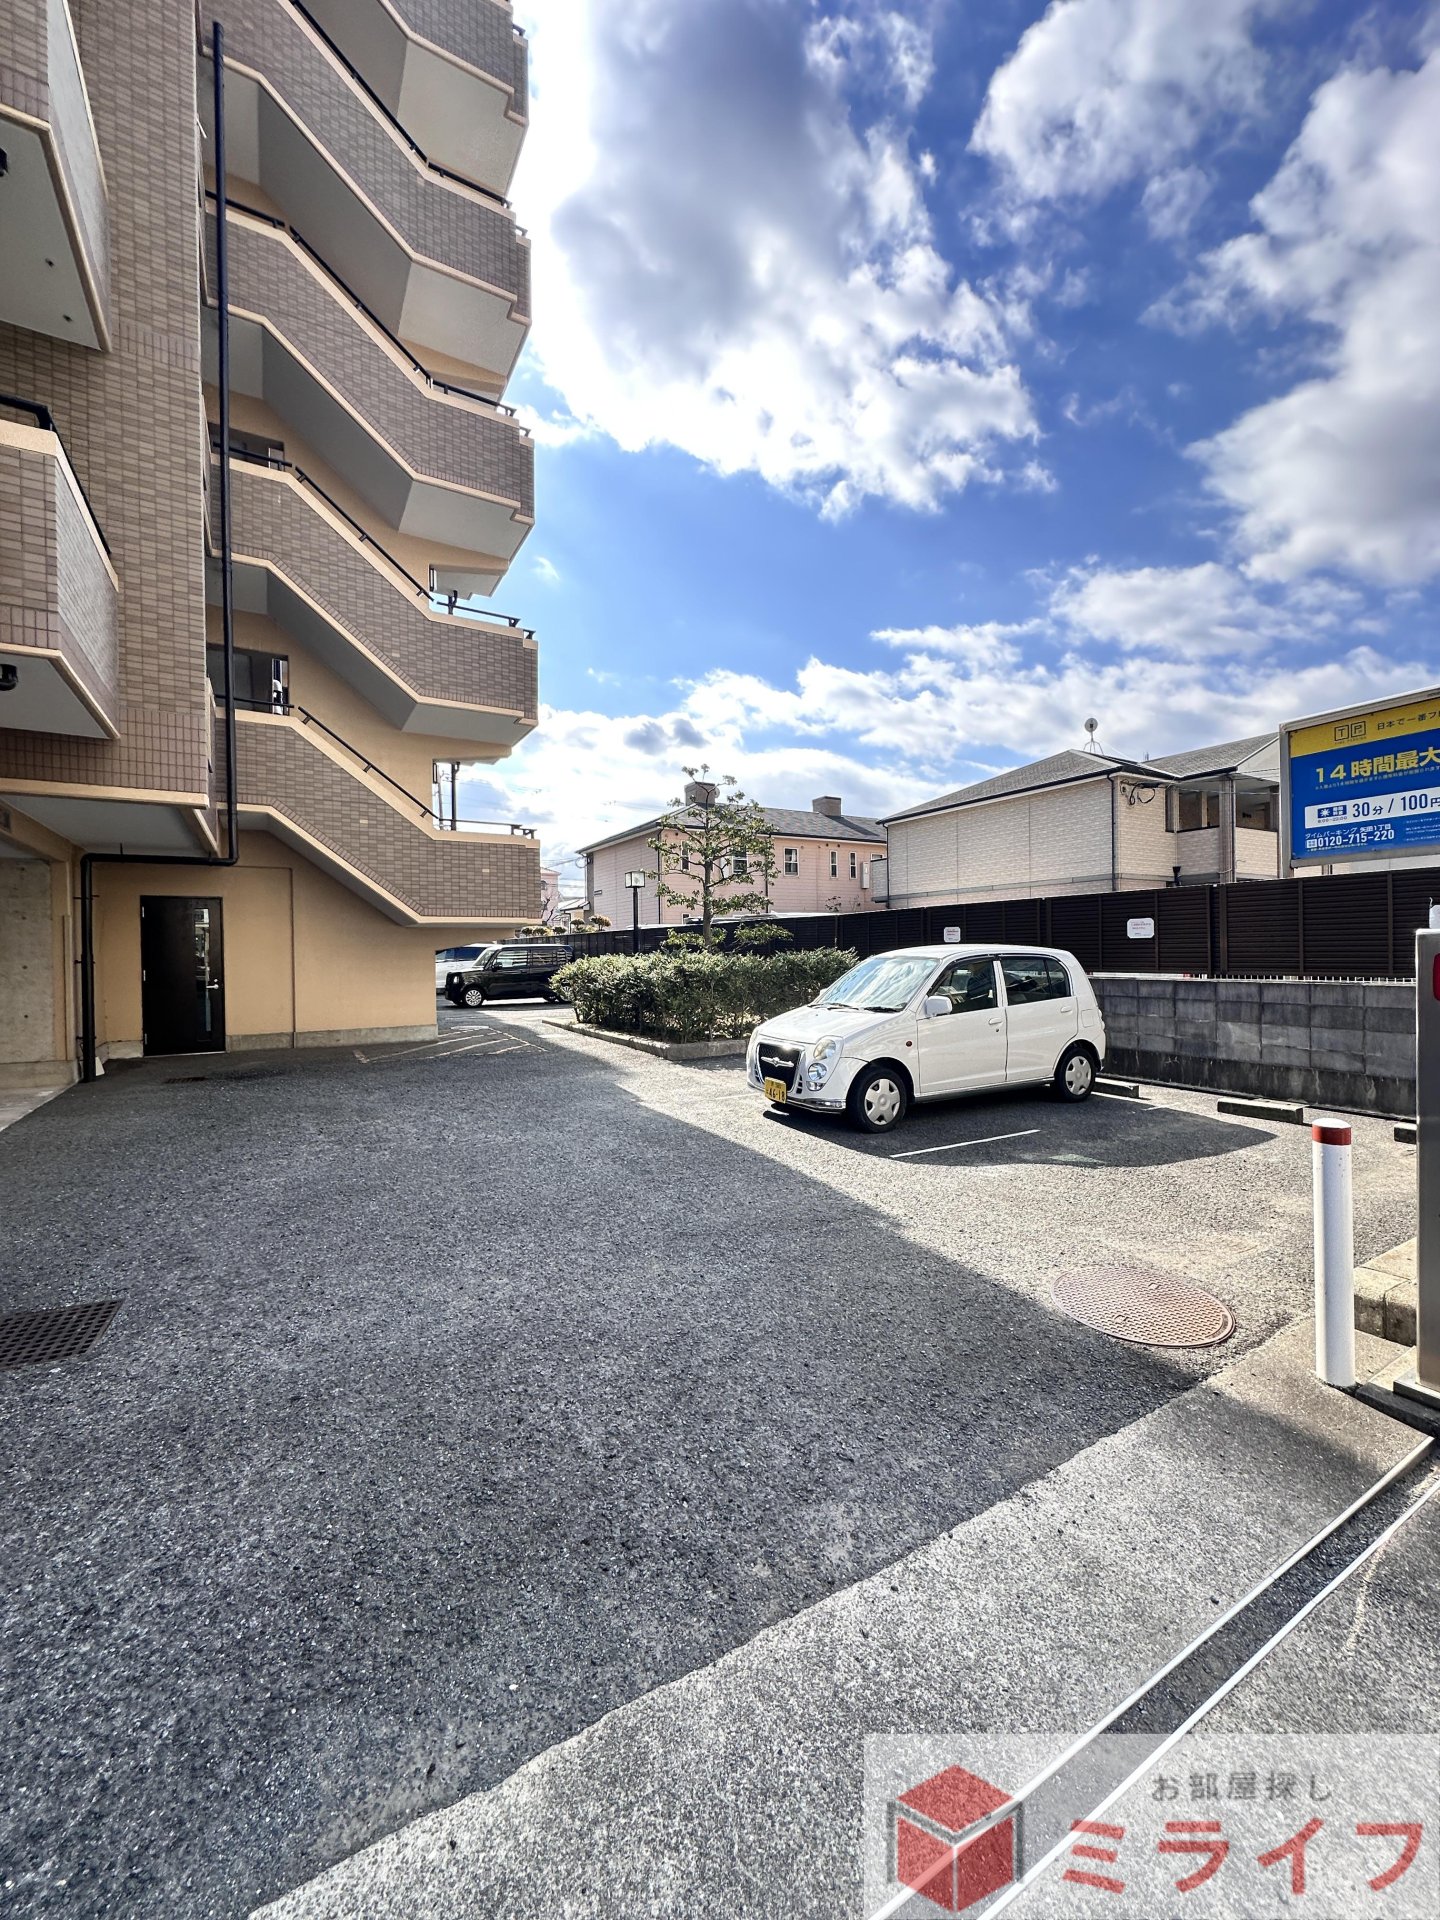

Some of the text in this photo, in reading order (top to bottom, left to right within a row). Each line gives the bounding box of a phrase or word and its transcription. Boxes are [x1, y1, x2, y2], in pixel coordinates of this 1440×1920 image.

[1377, 710, 1440, 731] 日本で一番フ
[1315, 747, 1440, 783] 14時間最大
[1318, 830, 1394, 847] 0120-715-220
